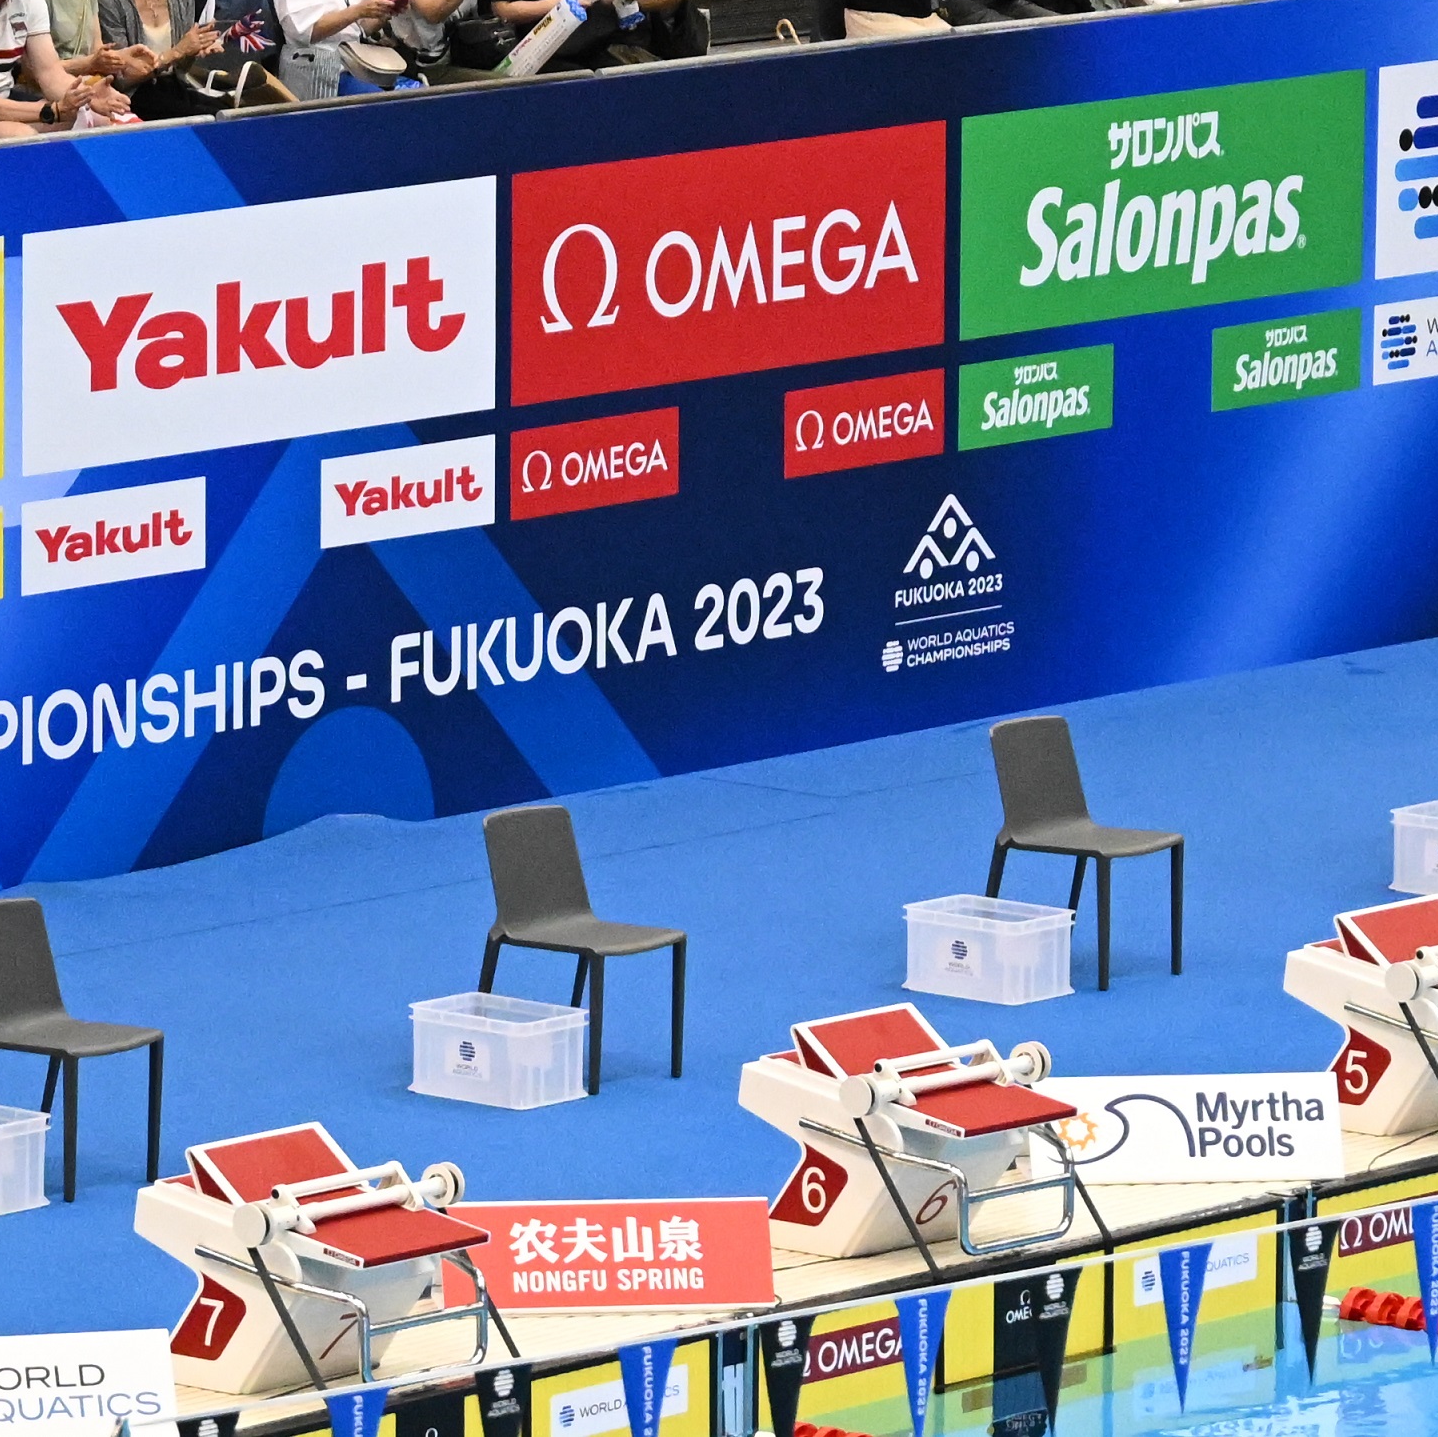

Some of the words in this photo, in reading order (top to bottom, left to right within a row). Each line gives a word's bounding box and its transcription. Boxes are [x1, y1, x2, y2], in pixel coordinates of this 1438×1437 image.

[532, 14, 553, 35] Nikon
[1107, 110, 1223, 170] サロンパス
[1019, 173, 1305, 284] Salonpas
[645, 199, 920, 319] OMEGA
[56, 256, 466, 392] Yakult
[1233, 345, 1338, 392] Salonpas
[832, 399, 935, 447] OMEGA
[980, 383, 1091, 432] Salonpas
[561, 438, 668, 487] OMEGA
[335, 465, 483, 516] Yakult
[35, 509, 193, 563] Yakult
[894, 580, 965, 609] FUKUOKA
[967, 573, 1004, 596] 2023
[390, 592, 678, 705] FUKUOKA
[693, 566, 825, 653] 2023
[906, 638, 1011, 668] CHAMPIONSHIPS
[907, 632, 953, 652] WORLD
[954, 621, 1015, 643] AQUATICS
[1344, 1049, 1369, 1097] 5
[1196, 1091, 1325, 1130] Myrtha
[1200, 1126, 1296, 1158] Pools
[801, 1165, 826, 1215] 6
[509, 1215, 705, 1265] 农夫山泉
[512, 1270, 608, 1294] NONGFU
[617, 1267, 705, 1292] SPRING
[1179, 1251, 1190, 1324] FUKUOKA
[200, 1296, 224, 1347] 7
[918, 1298, 928, 1375] FUKUOKA
[579, 1398, 622, 1419] WORLD
[642, 1345, 654, 1424] FUKUOKA
